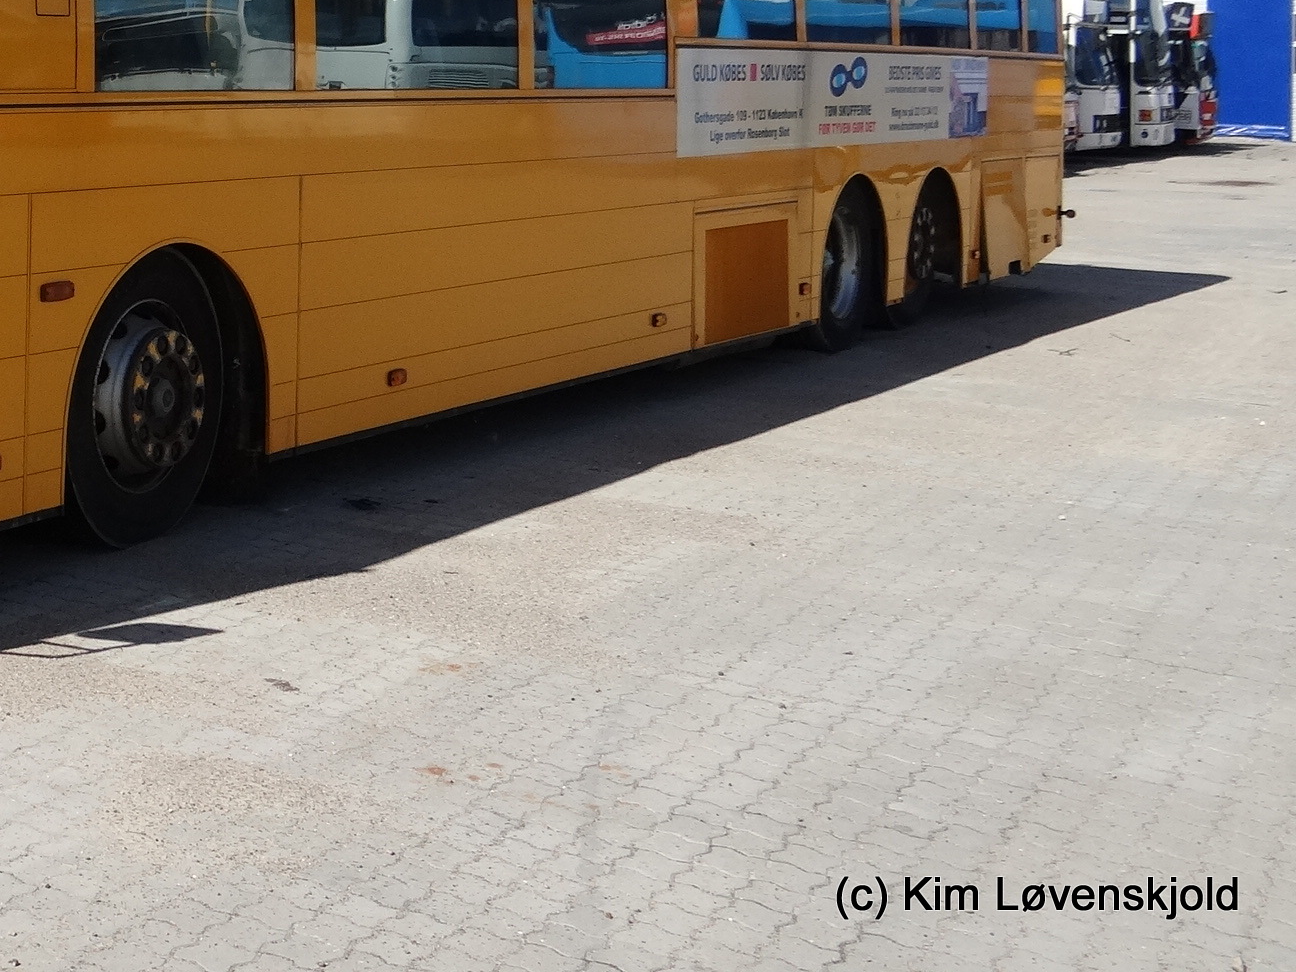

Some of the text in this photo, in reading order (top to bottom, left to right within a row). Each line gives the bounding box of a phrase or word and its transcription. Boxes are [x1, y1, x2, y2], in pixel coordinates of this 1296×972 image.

[693, 64, 806, 82] GULD KØBES SØLV KØBES
